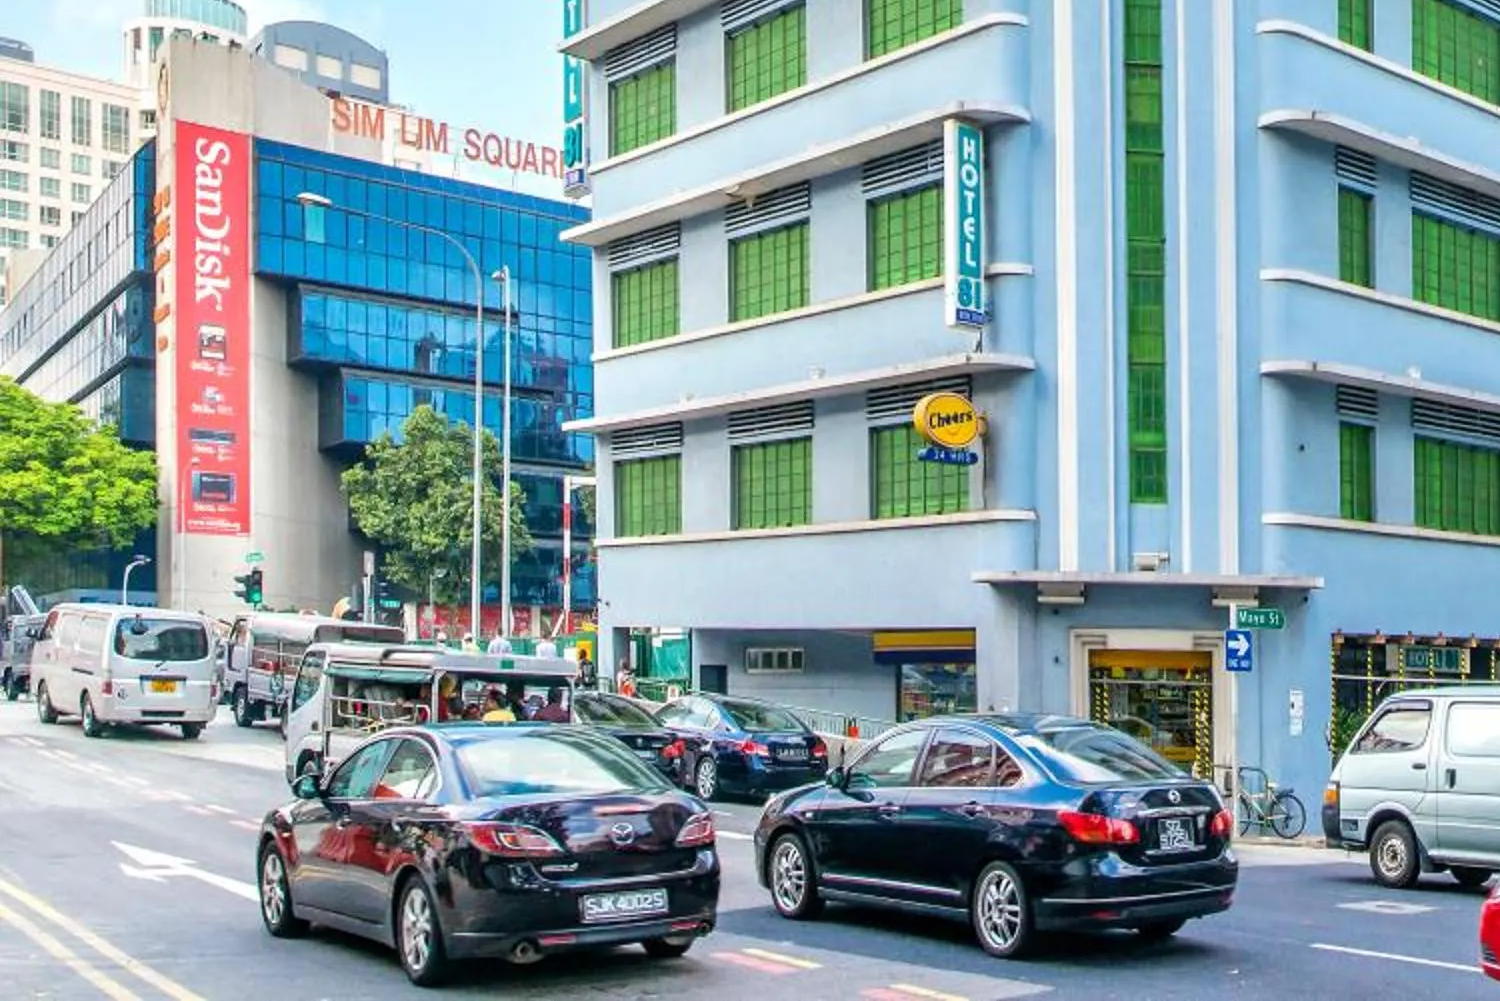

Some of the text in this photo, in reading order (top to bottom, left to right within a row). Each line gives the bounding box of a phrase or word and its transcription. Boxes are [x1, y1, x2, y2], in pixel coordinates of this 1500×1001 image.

[332, 98, 385, 141] SIM
[401, 113, 449, 154] LIM
[463, 128, 564, 179] SQUAR
[961, 136, 979, 268] HOTEL
[194, 137, 231, 303] SanDisk
[957, 278, 981, 309] 81
[929, 410, 973, 429] Cheers
[1268, 612, 1280, 625] St
[585, 892, 664, 914] SJK4002S
